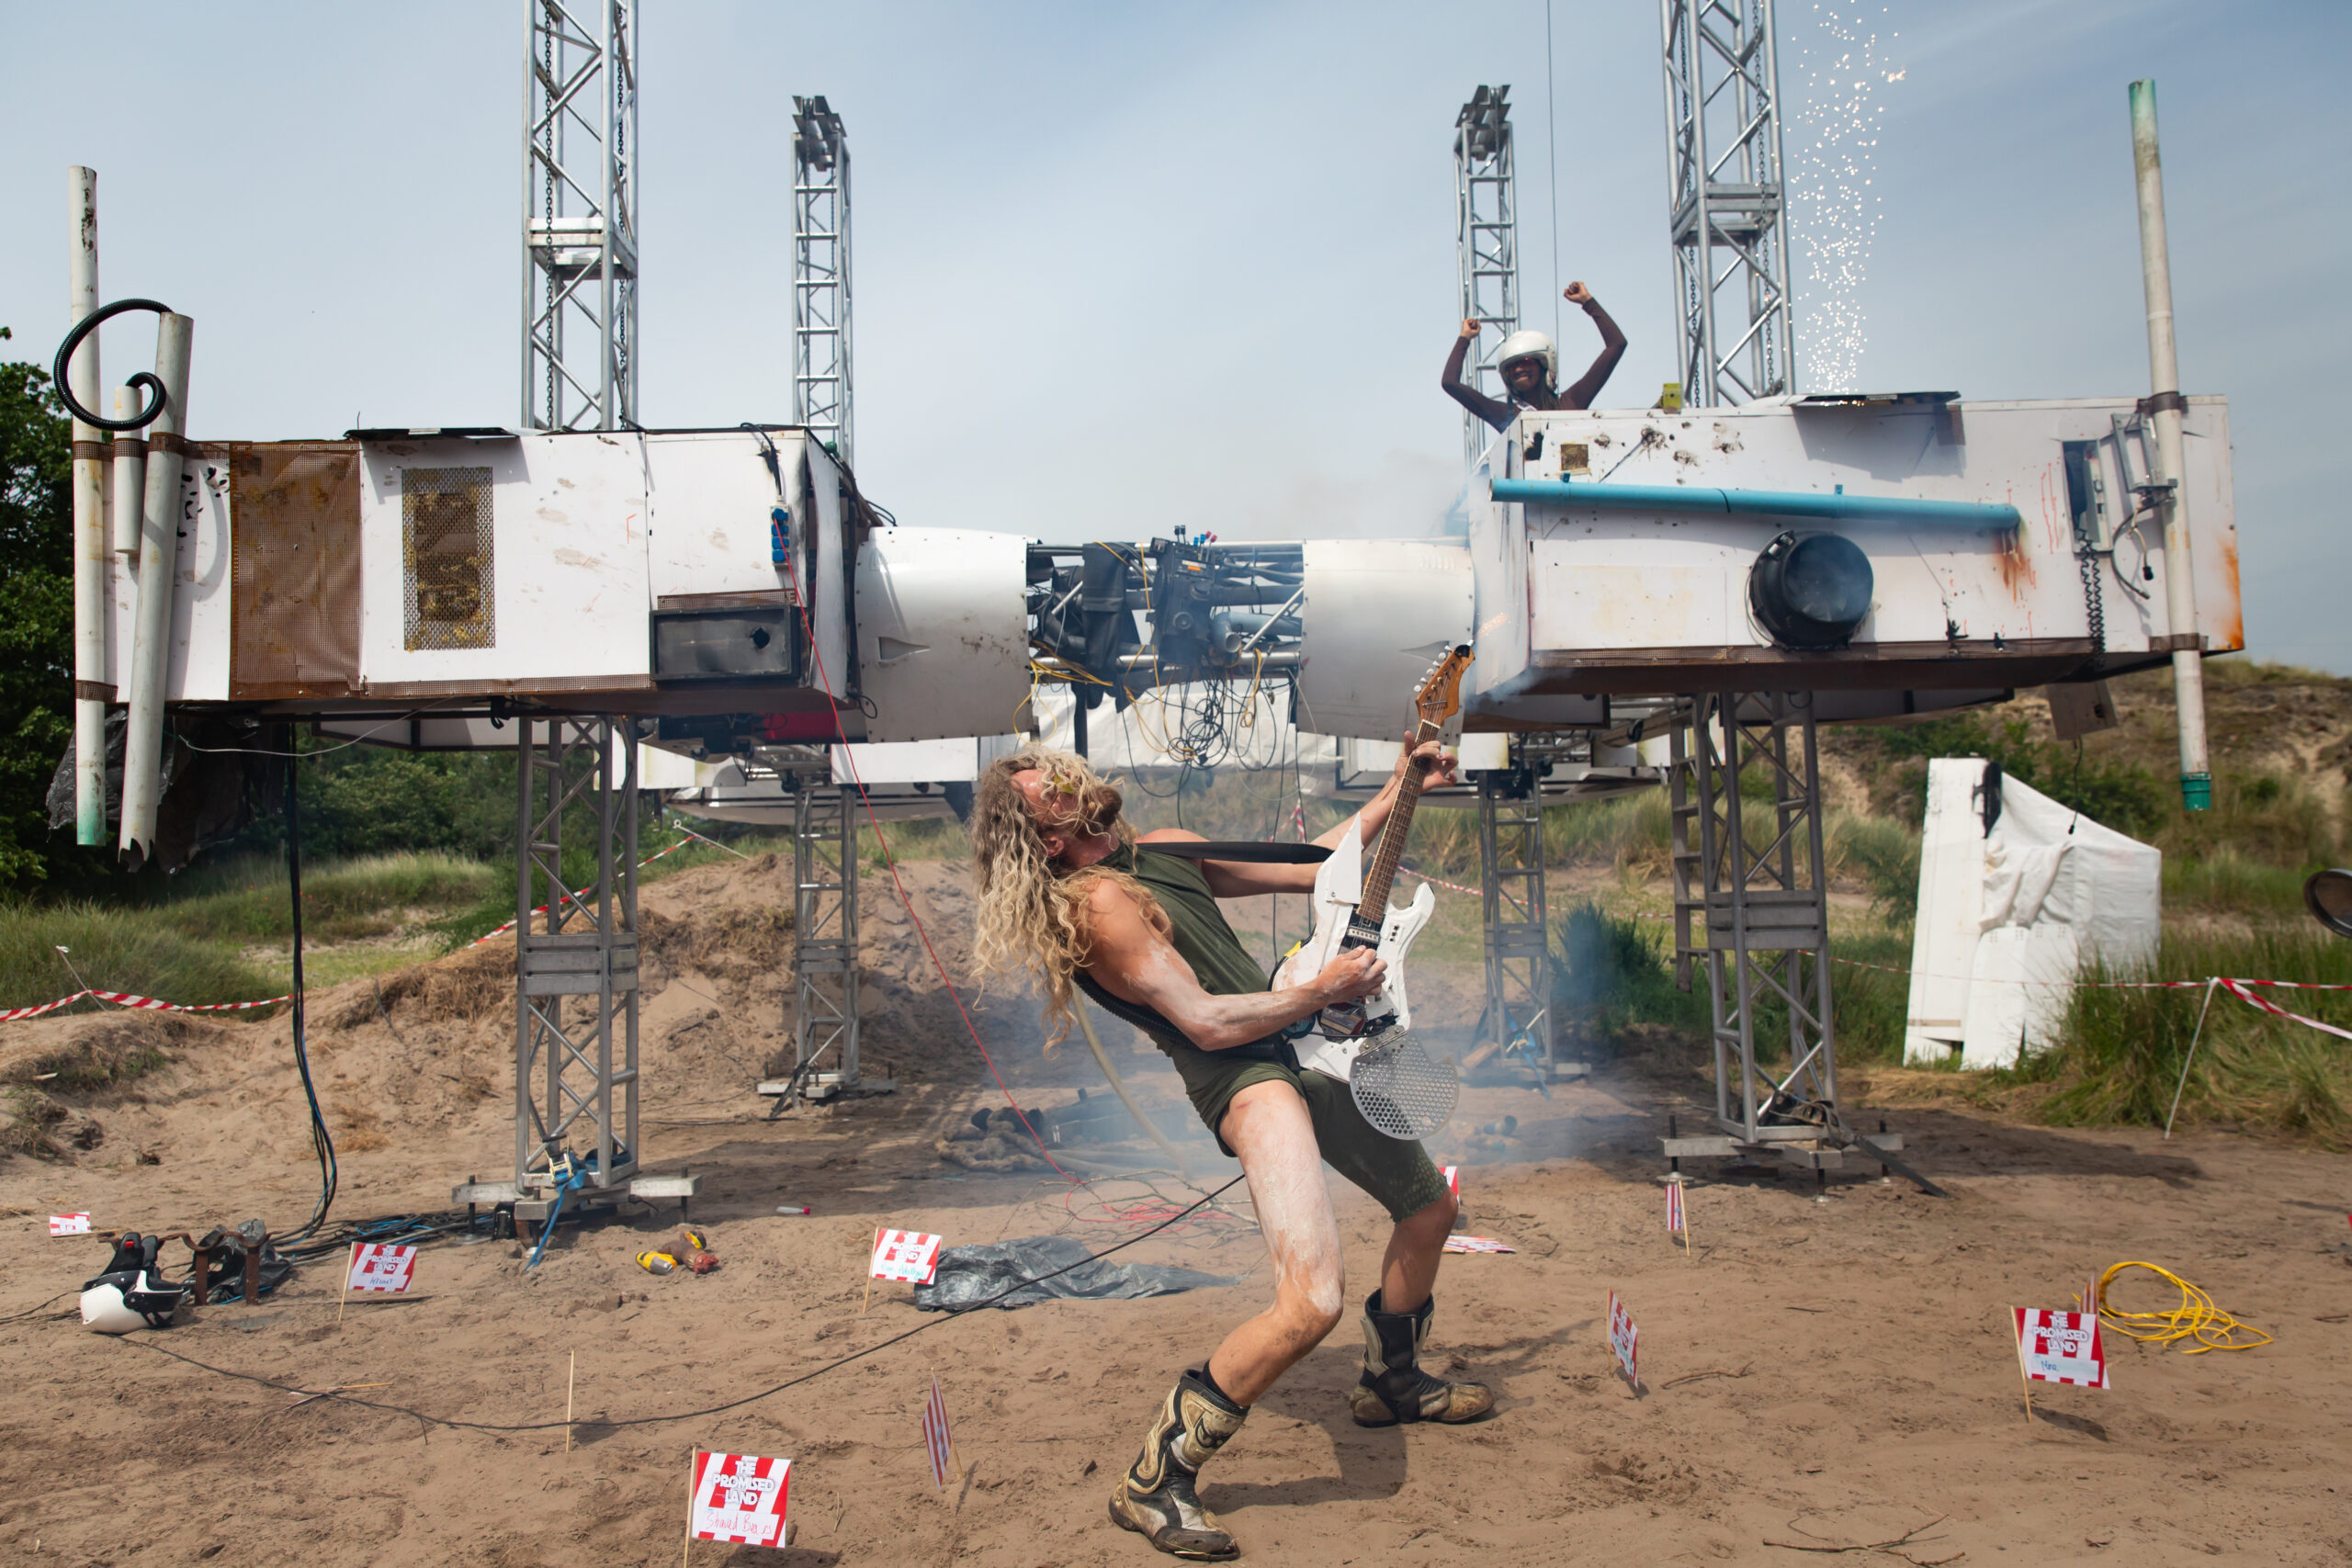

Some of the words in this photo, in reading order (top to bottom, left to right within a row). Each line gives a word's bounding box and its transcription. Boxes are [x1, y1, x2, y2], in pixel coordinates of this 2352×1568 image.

[2049, 1314, 2069, 1329] THE
[2031, 1325, 2089, 1343] PROMISED
[2046, 1338, 2077, 1353] LAND
[734, 1460, 757, 1476] THE
[712, 1472, 775, 1493] PROMISED
[724, 1489, 758, 1506] LAND
